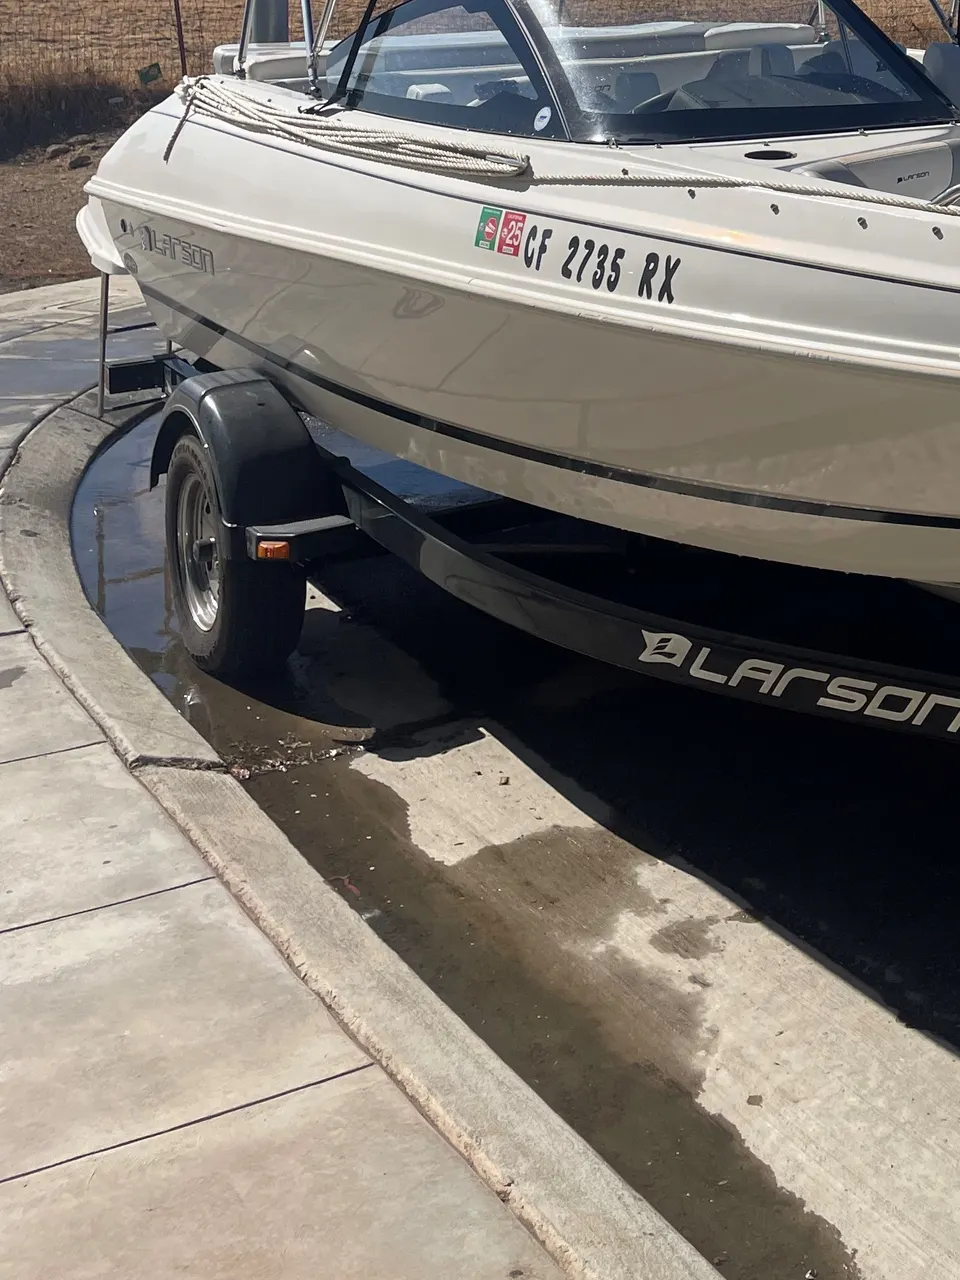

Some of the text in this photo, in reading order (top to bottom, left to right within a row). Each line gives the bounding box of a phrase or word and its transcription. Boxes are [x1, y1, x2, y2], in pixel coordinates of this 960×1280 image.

[505, 220, 523, 246] 25
[523, 224, 682, 304] CF 2735 RX
